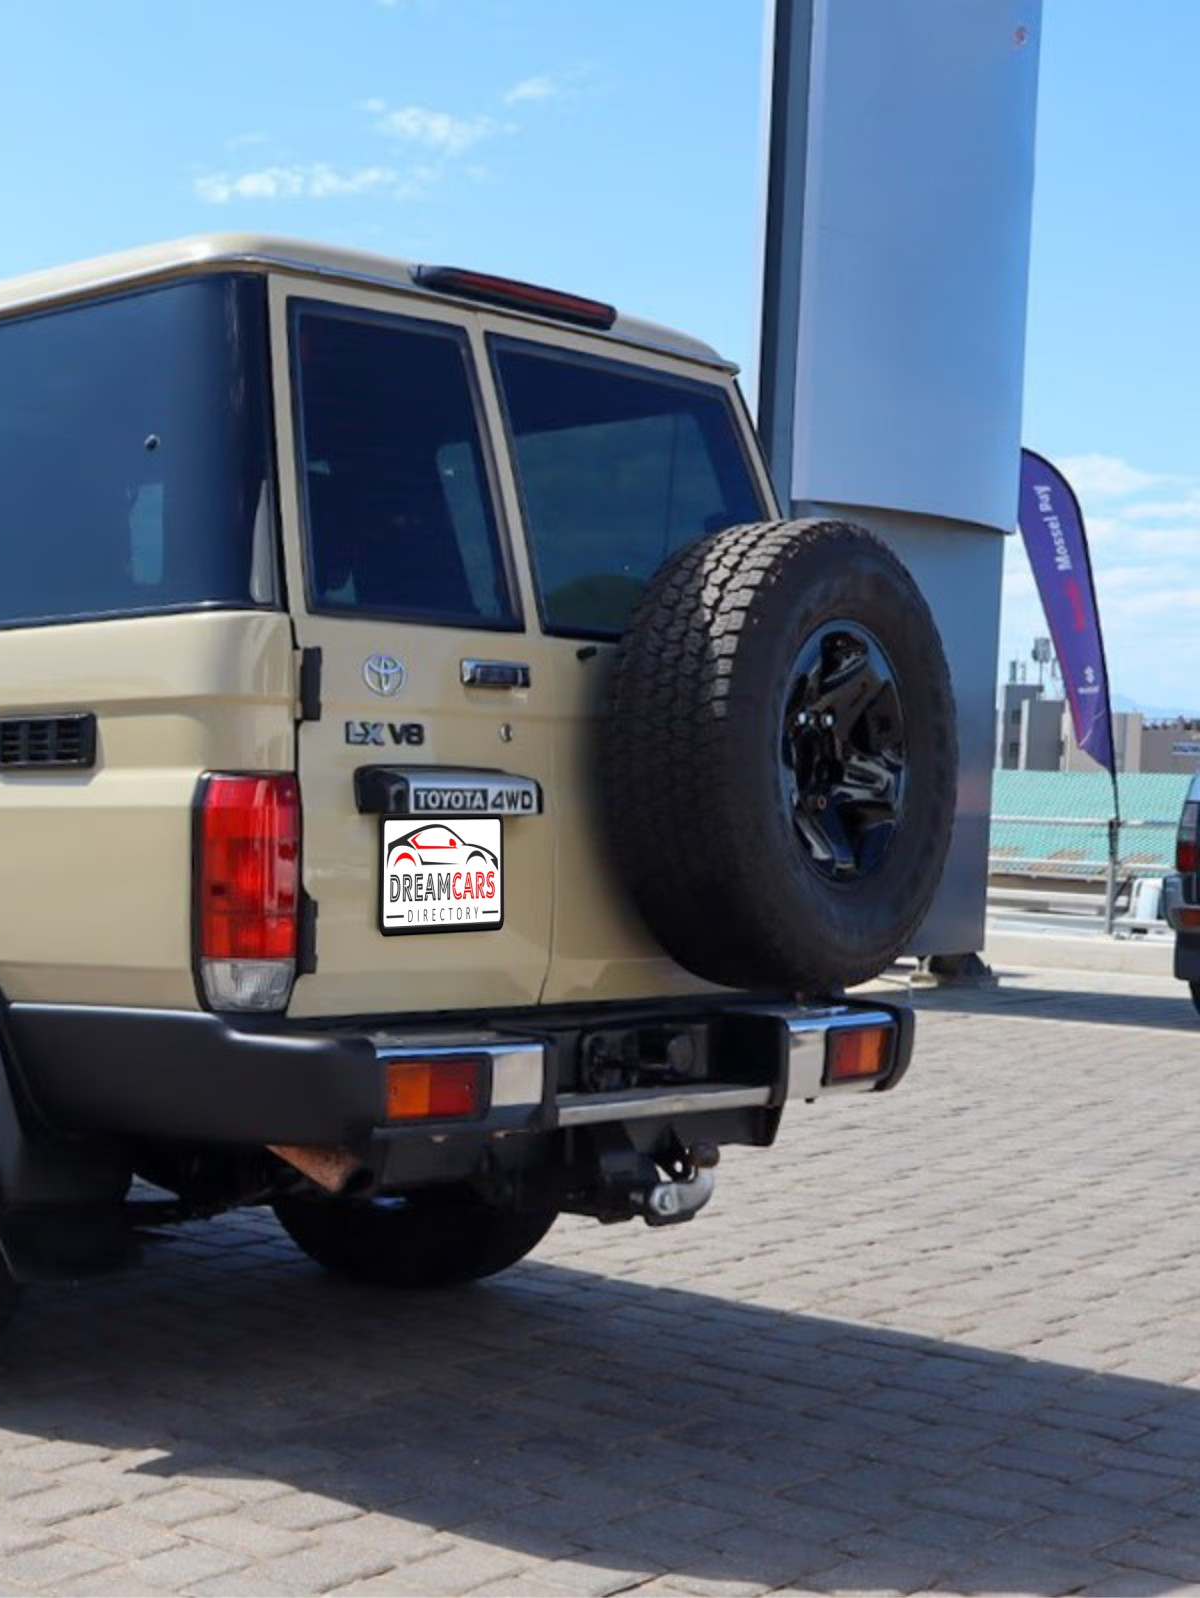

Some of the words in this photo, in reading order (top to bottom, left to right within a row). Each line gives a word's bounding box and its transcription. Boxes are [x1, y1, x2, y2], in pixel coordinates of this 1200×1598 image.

[345, 721, 385, 746] LX
[387, 723, 425, 745] V8
[415, 790, 486, 809] TOYOTA
[490, 790, 534, 811] 4WD
